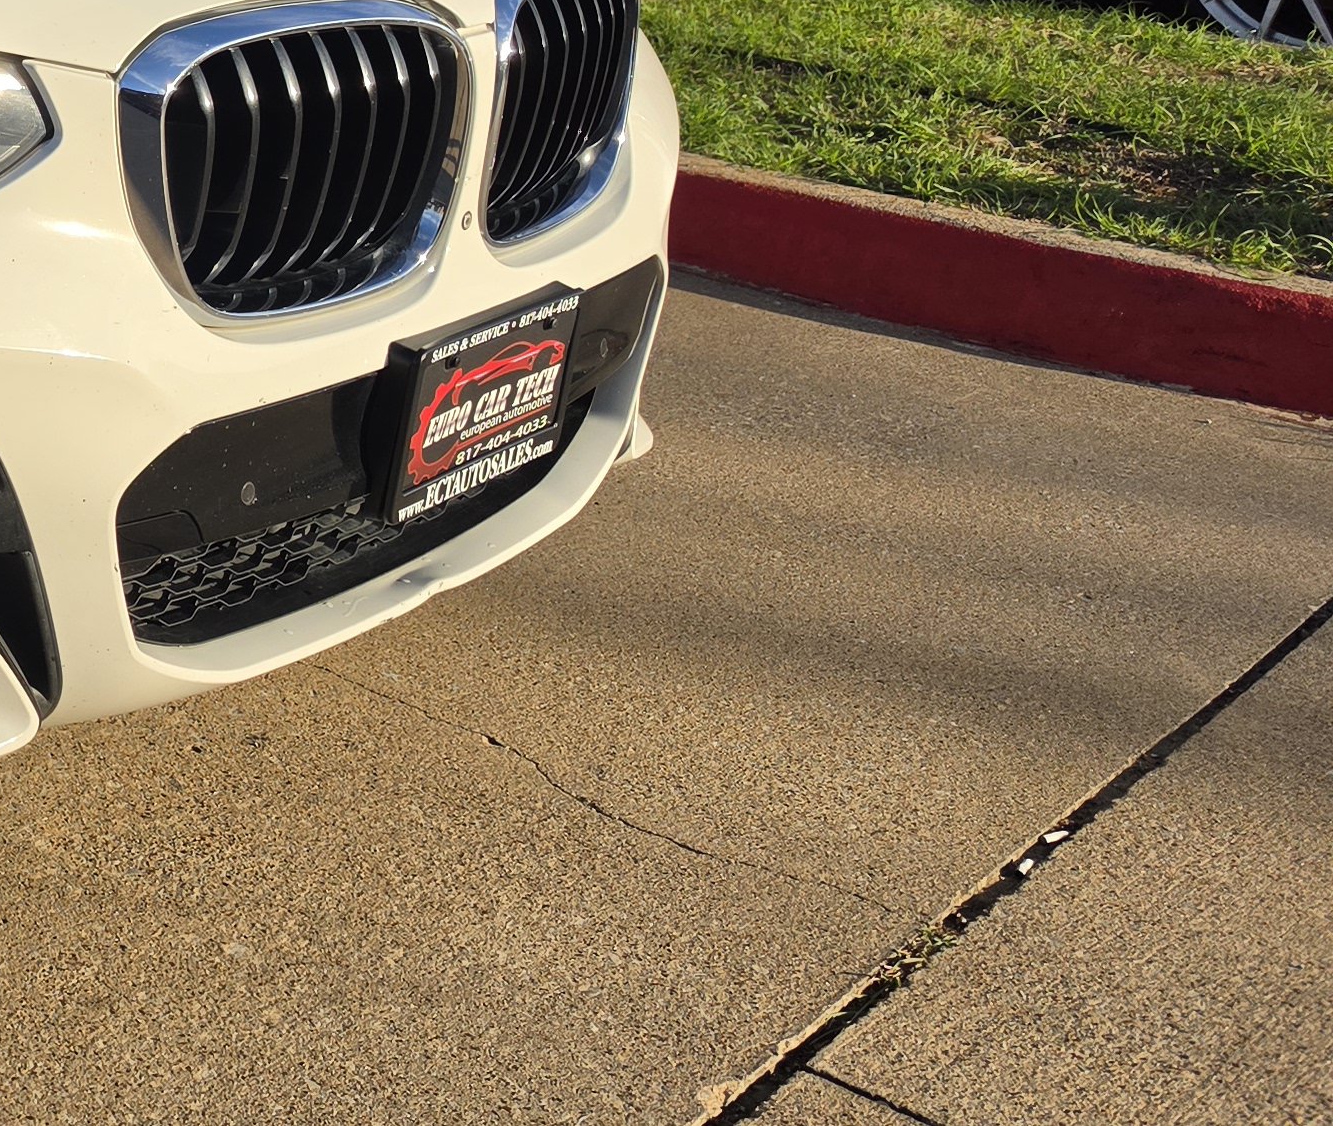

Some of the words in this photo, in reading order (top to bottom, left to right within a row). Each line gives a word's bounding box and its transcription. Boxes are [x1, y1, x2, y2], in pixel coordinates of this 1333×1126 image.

[431, 340, 459, 363] SALES
[460, 337, 468, 351] &
[469, 322, 510, 348] SERVICE
[519, 296, 579, 328] 817-404-4033
[423, 400, 472, 448] EURO
[474, 384, 511, 423] CAR
[512, 364, 561, 407] TECH
[460, 415, 501, 440] european
[503, 394, 553, 421] automotive
[455, 415, 548, 465] 817-404-4033
[398, 438, 553, 522] www.ECTAUTOSALES.com
